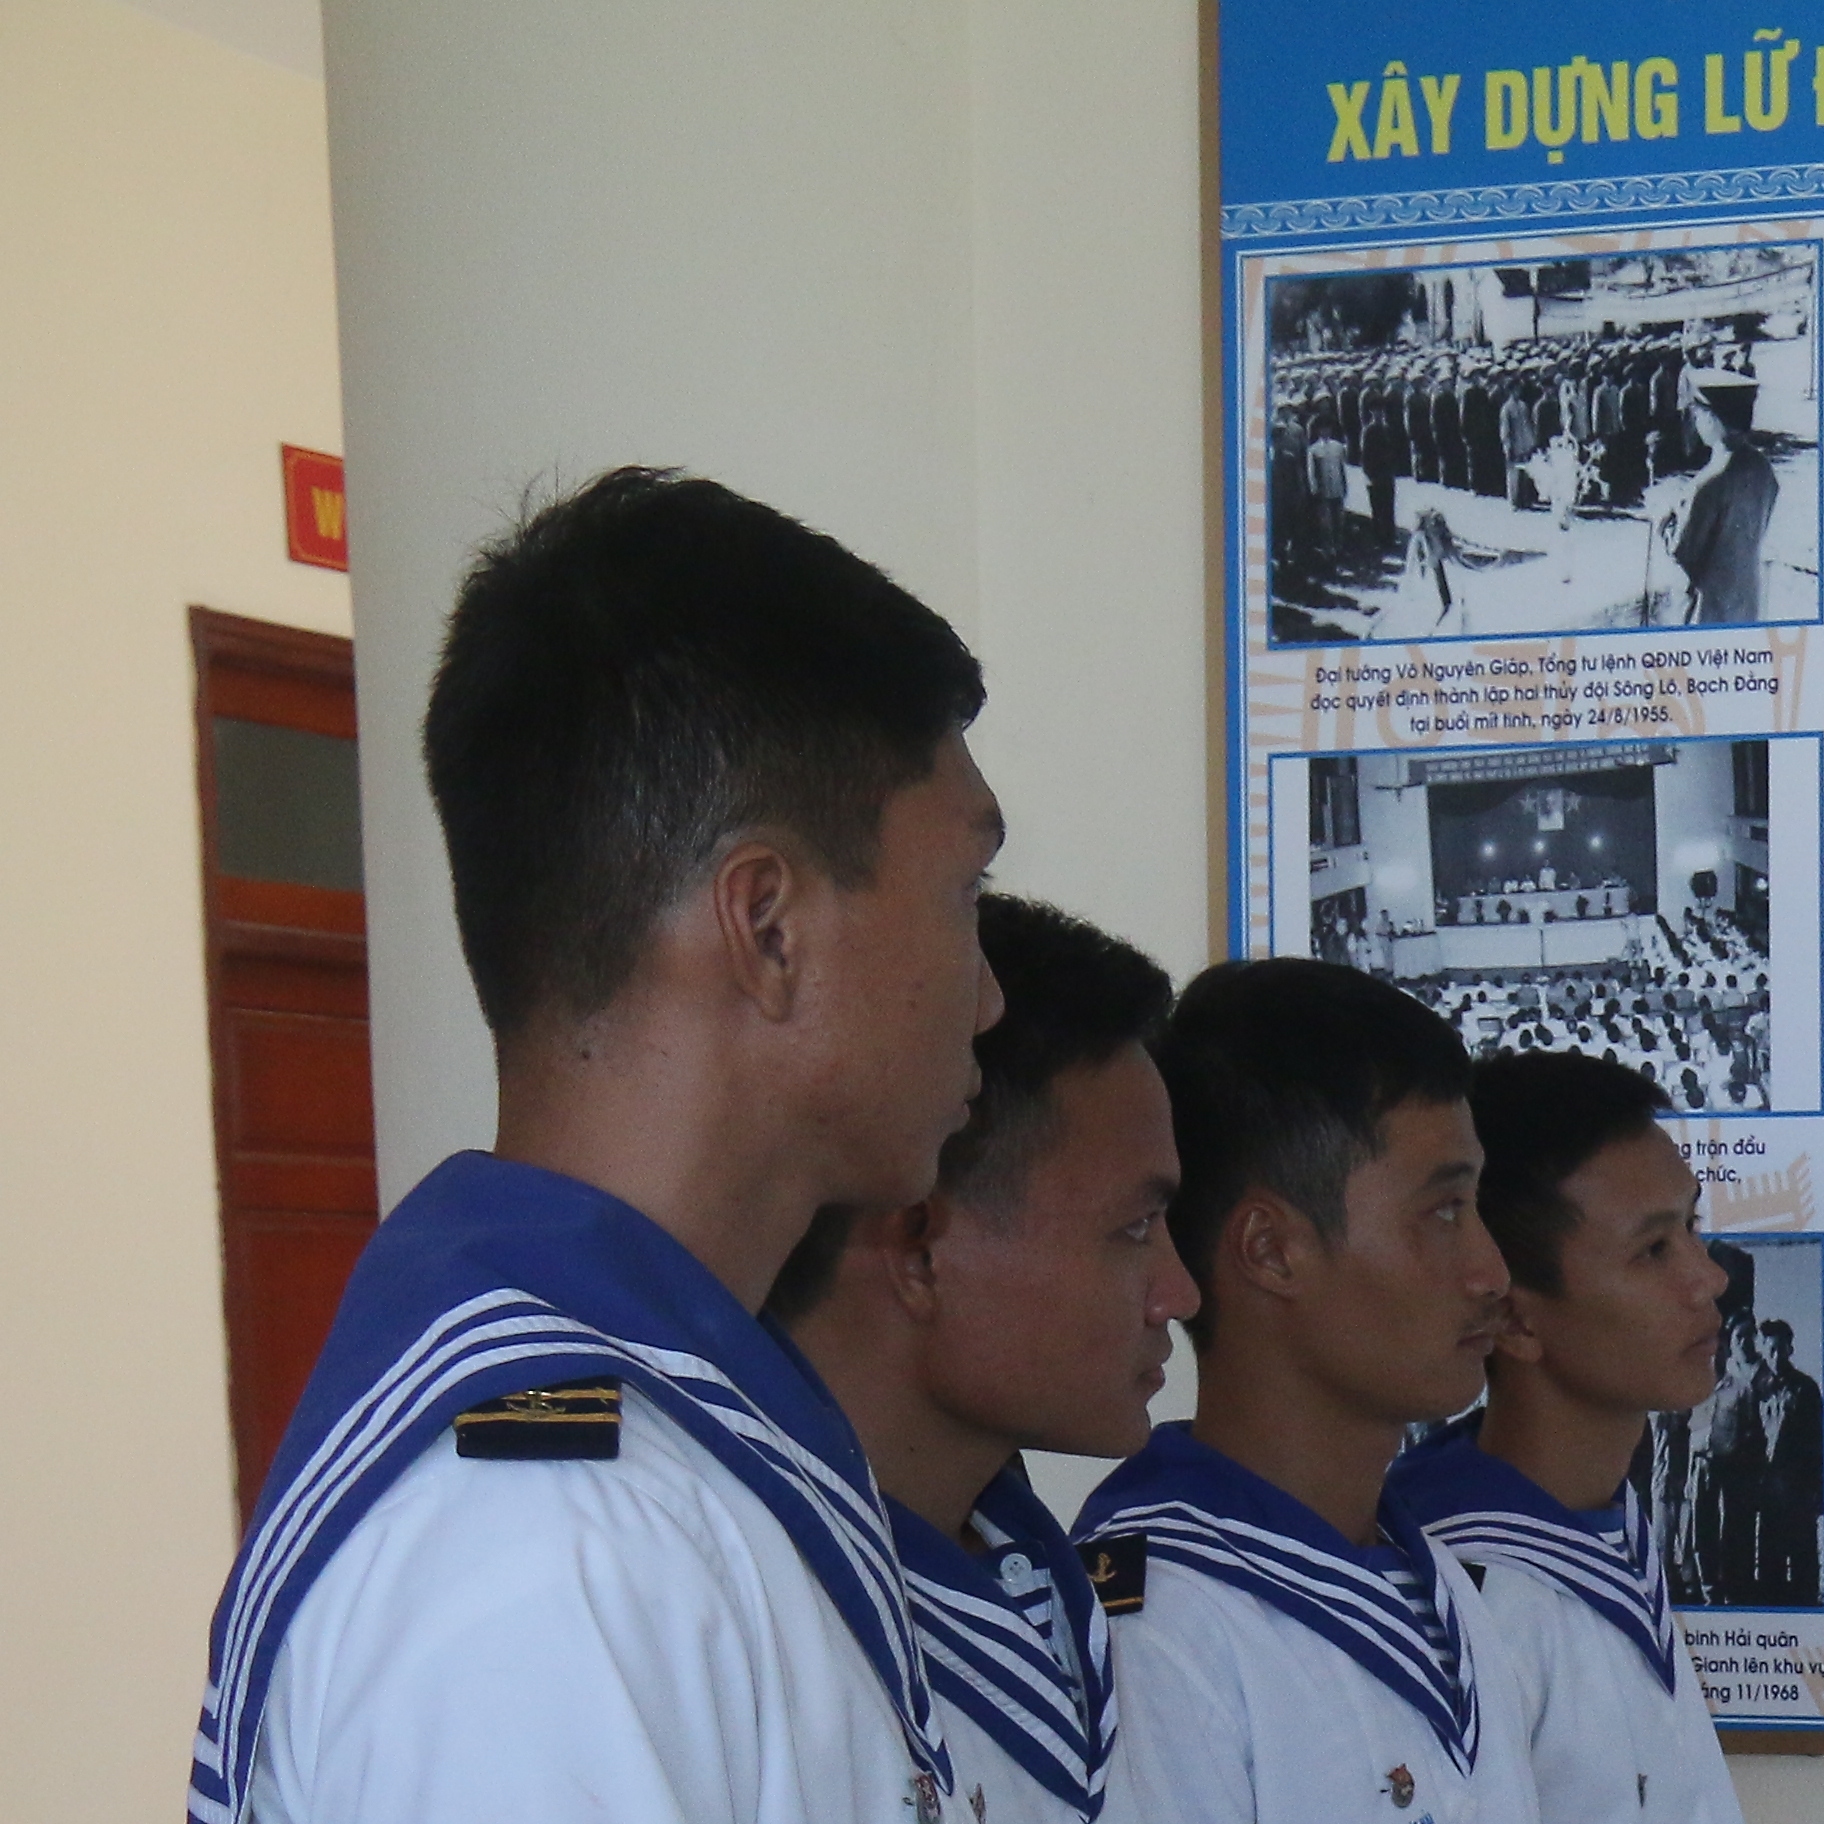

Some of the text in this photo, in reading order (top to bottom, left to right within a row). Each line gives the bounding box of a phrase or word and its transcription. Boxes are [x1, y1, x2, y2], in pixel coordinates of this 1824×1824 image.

[1328, 61, 1460, 161] XÂY
[1485, 56, 1678, 163] DỰNG
[1706, 29, 1800, 133] LỮ
[1695, 1138, 1729, 1161] trận
[1732, 1134, 1766, 1156] đầu
[1694, 1164, 1742, 1185] chức,
[1683, 1627, 1799, 1651] binh Hải quân
[1737, 1683, 1800, 1702] 11/1968
